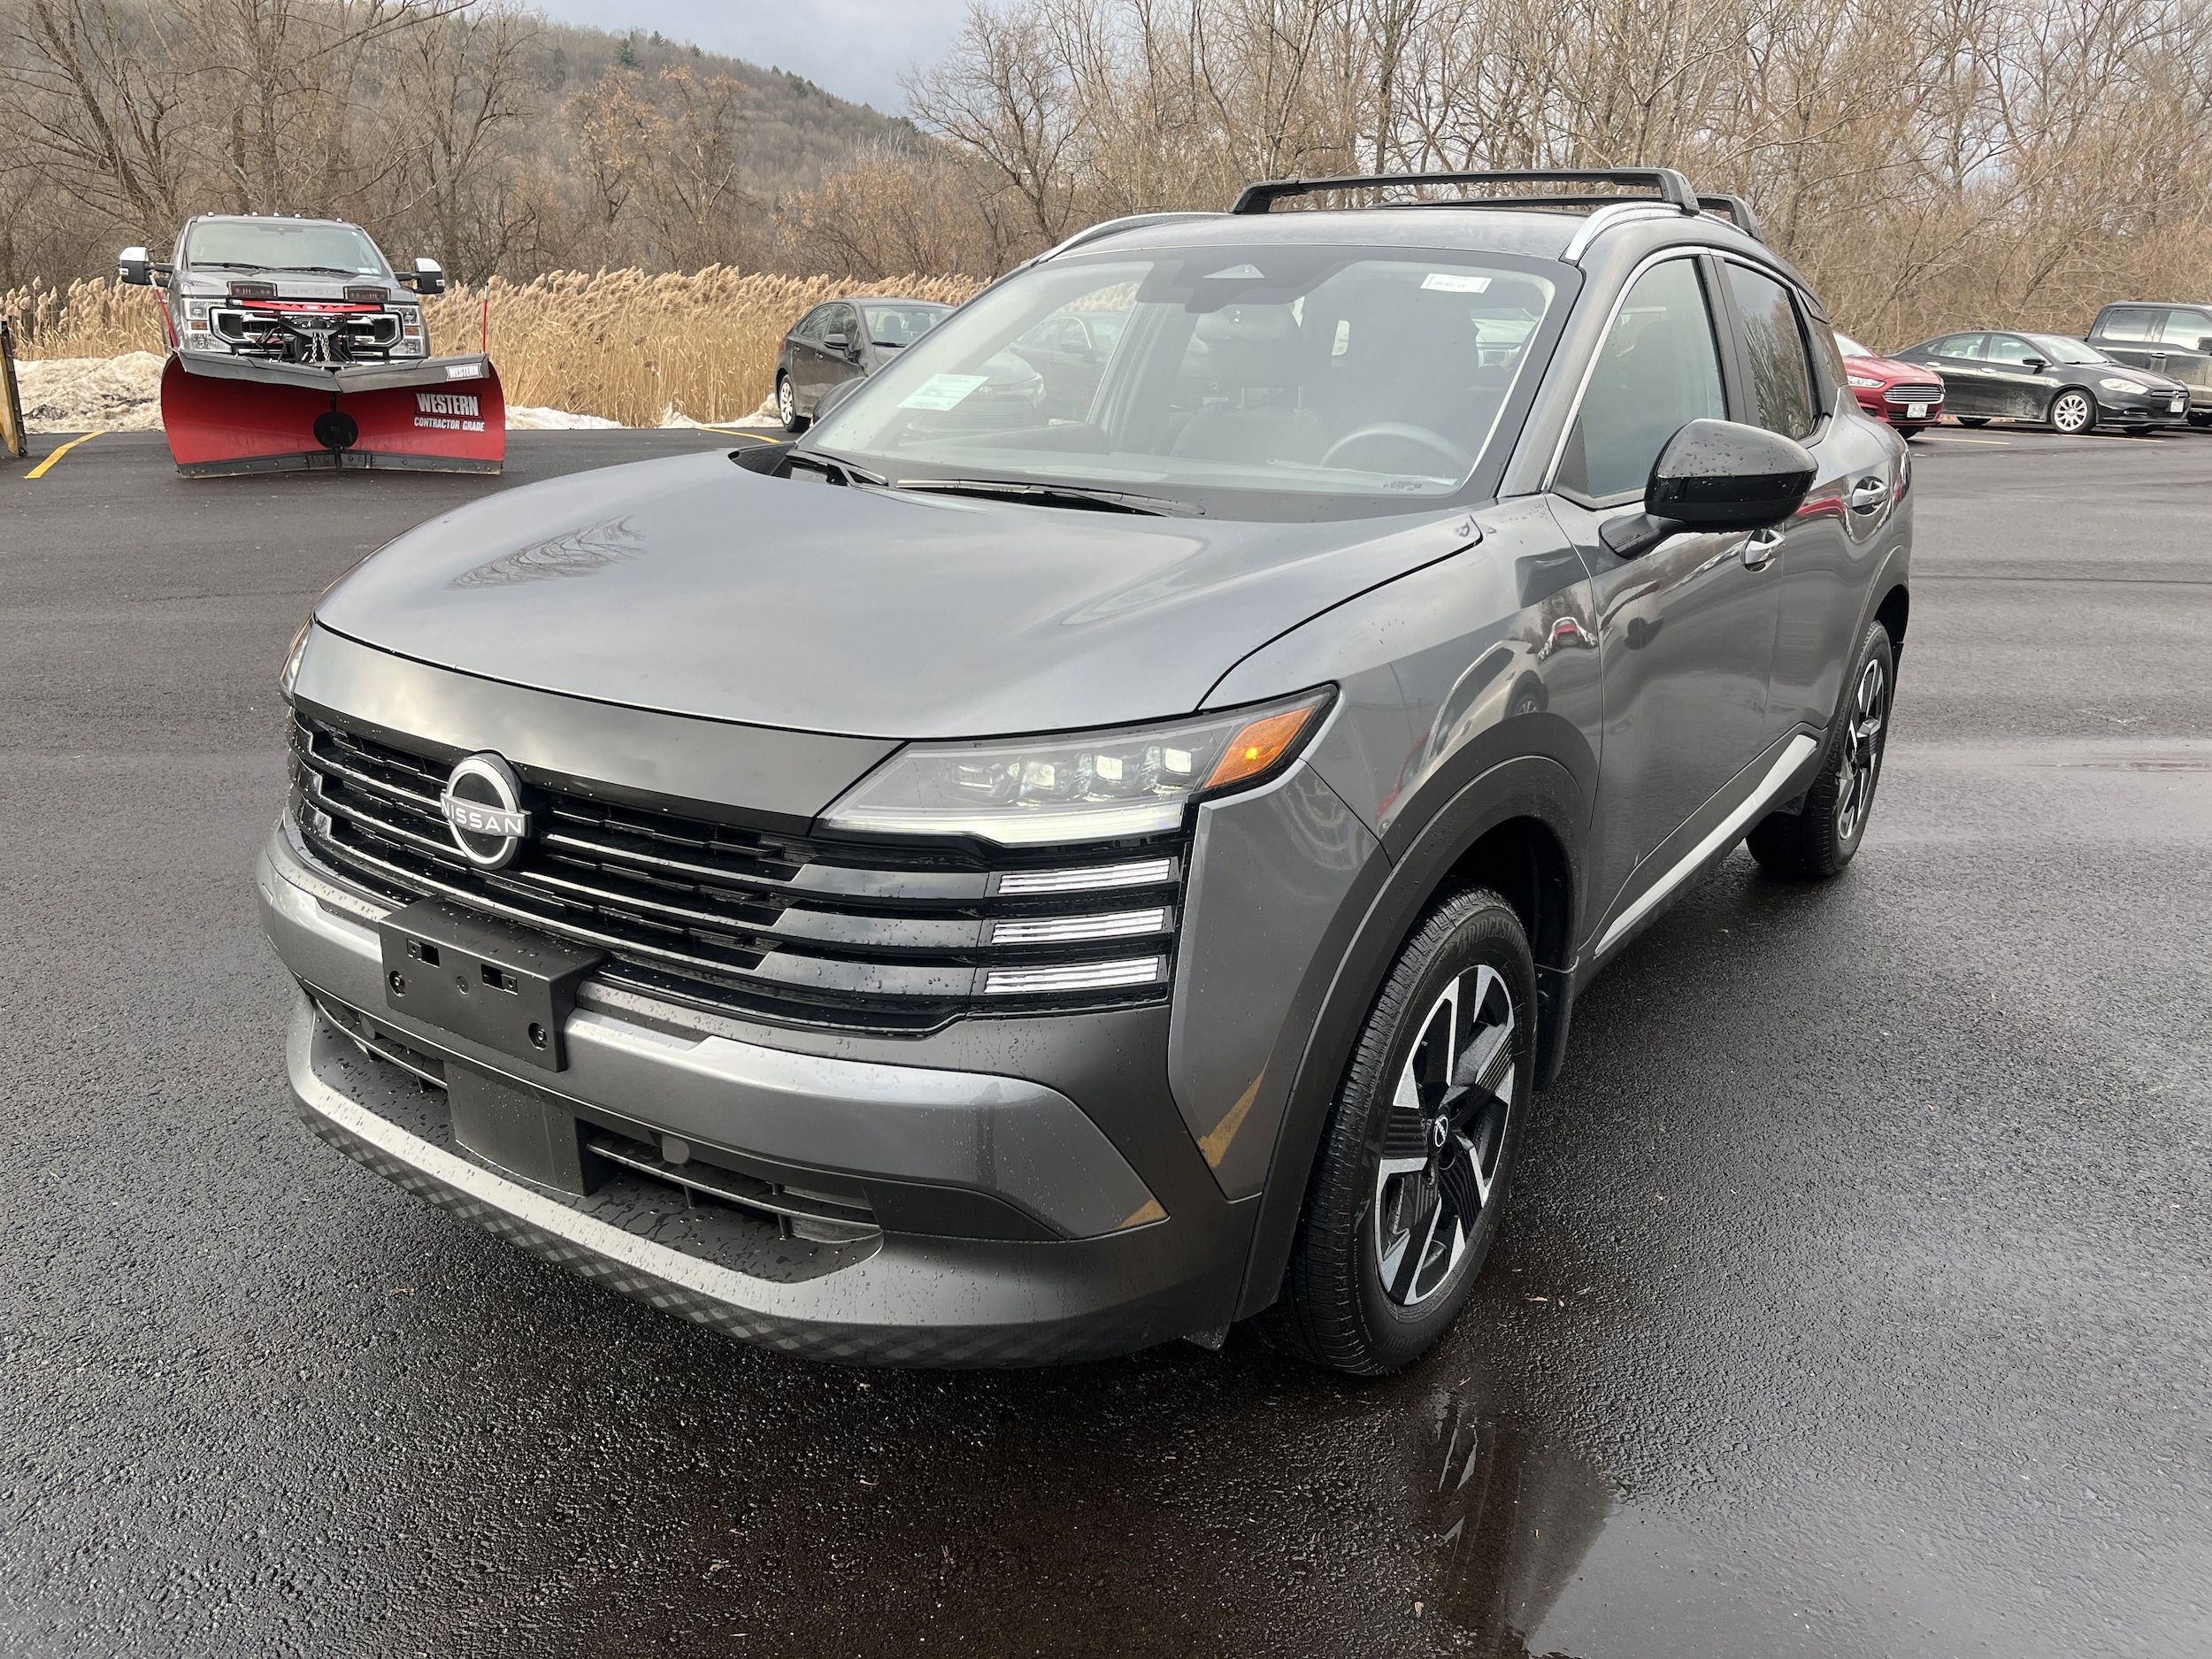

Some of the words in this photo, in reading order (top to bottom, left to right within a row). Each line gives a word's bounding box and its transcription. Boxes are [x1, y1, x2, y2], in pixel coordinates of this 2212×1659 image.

[449, 365, 479, 377] WESTERN
[416, 393, 479, 416] WESTERN
[414, 417, 460, 429] CONTRACTOR
[462, 420, 485, 432] GRADE
[441, 798, 522, 834] NISSAN
